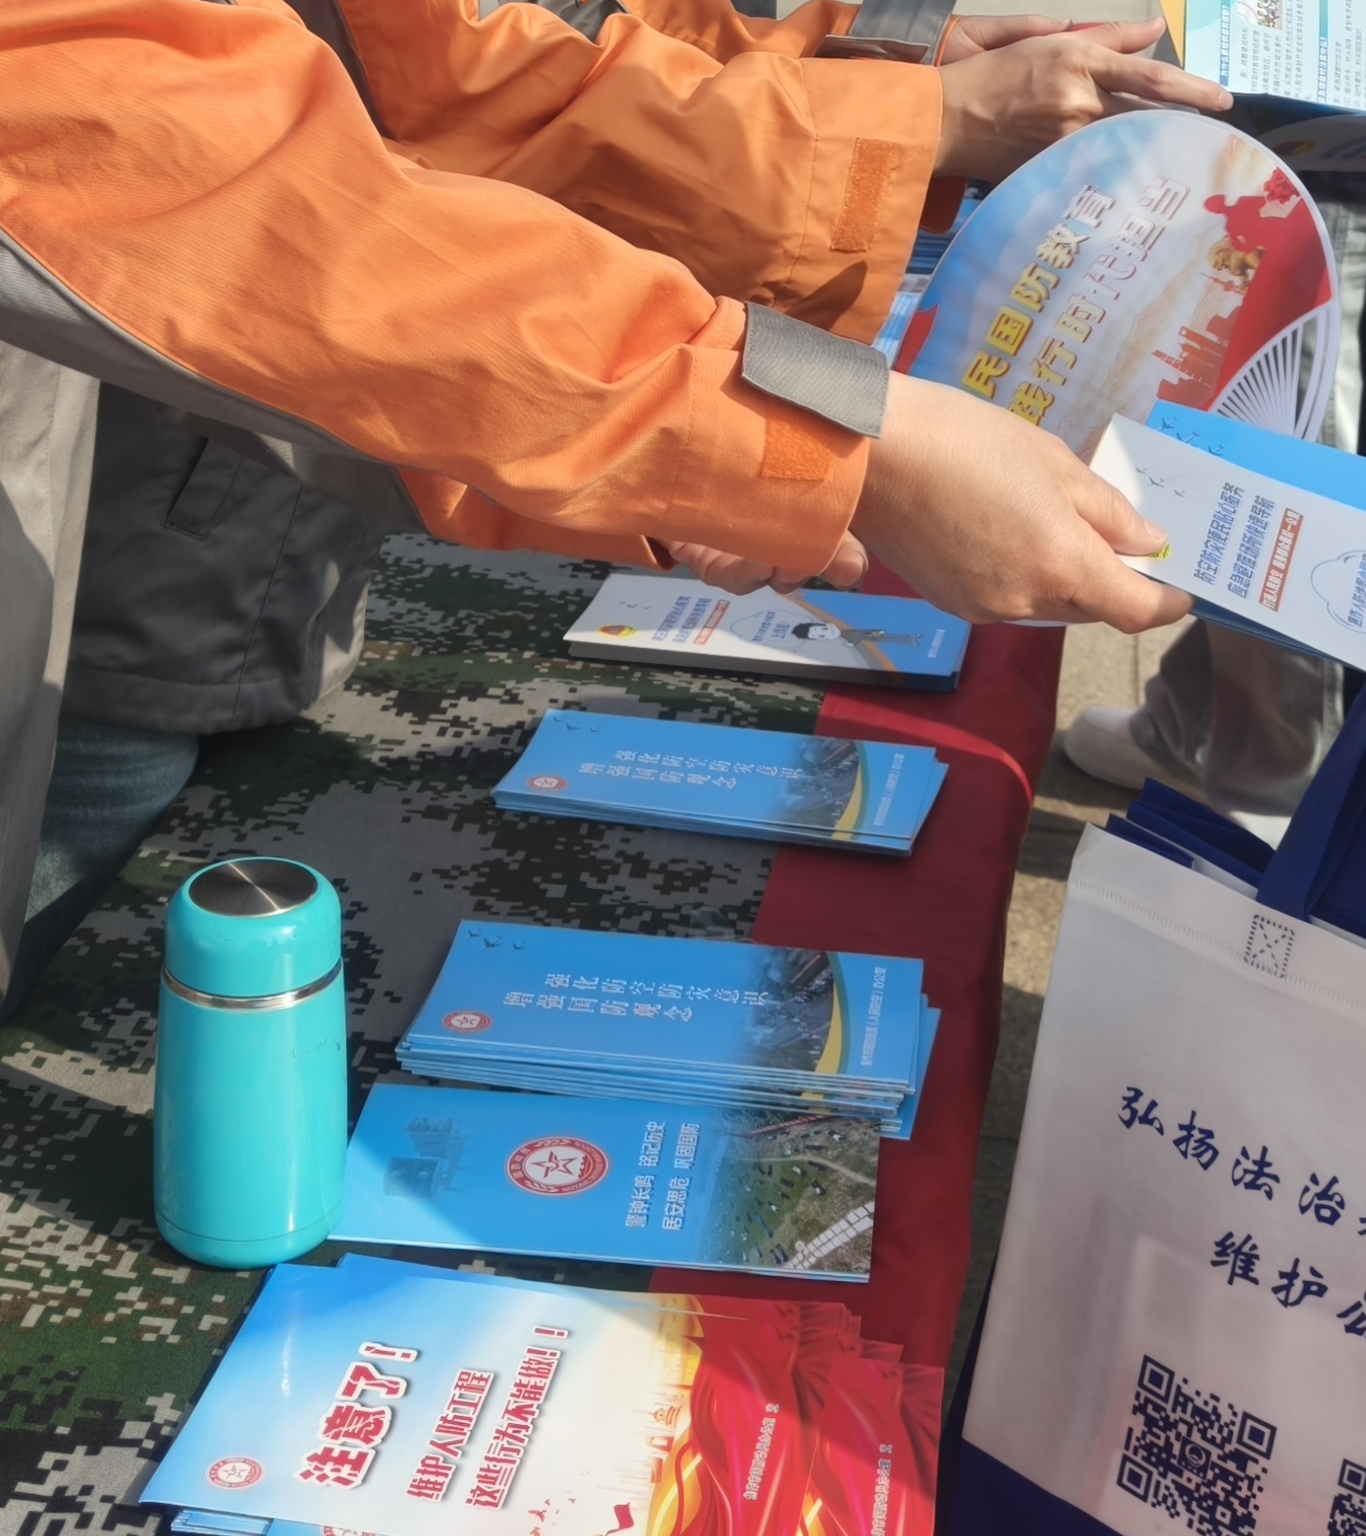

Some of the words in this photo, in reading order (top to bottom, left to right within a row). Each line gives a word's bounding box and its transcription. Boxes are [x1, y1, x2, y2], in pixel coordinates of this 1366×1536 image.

[961, 183, 1117, 400] 民国防教育
[1007, 174, 1192, 426] 践行时代担当
[1193, 481, 1246, 586] 防空防灾便民贴心服务
[1226, 494, 1276, 599] 应急避难场所快速导航
[578, 762, 737, 790] 增强国防观念
[614, 750, 803, 779] 强化防空防灾意识
[502, 990, 694, 1023] 增强国防观念
[544, 972, 769, 1007] 强化防空防灾意识
[638, 1121, 666, 1167] 铭记历史
[674, 1123, 701, 1170] 巩固国防
[625, 1175, 656, 1228] 警钟长鸣
[662, 1176, 690, 1232] 居安思危
[292, 1340, 419, 1490] 注意了!
[405, 1368, 495, 1503] 维护人防工程
